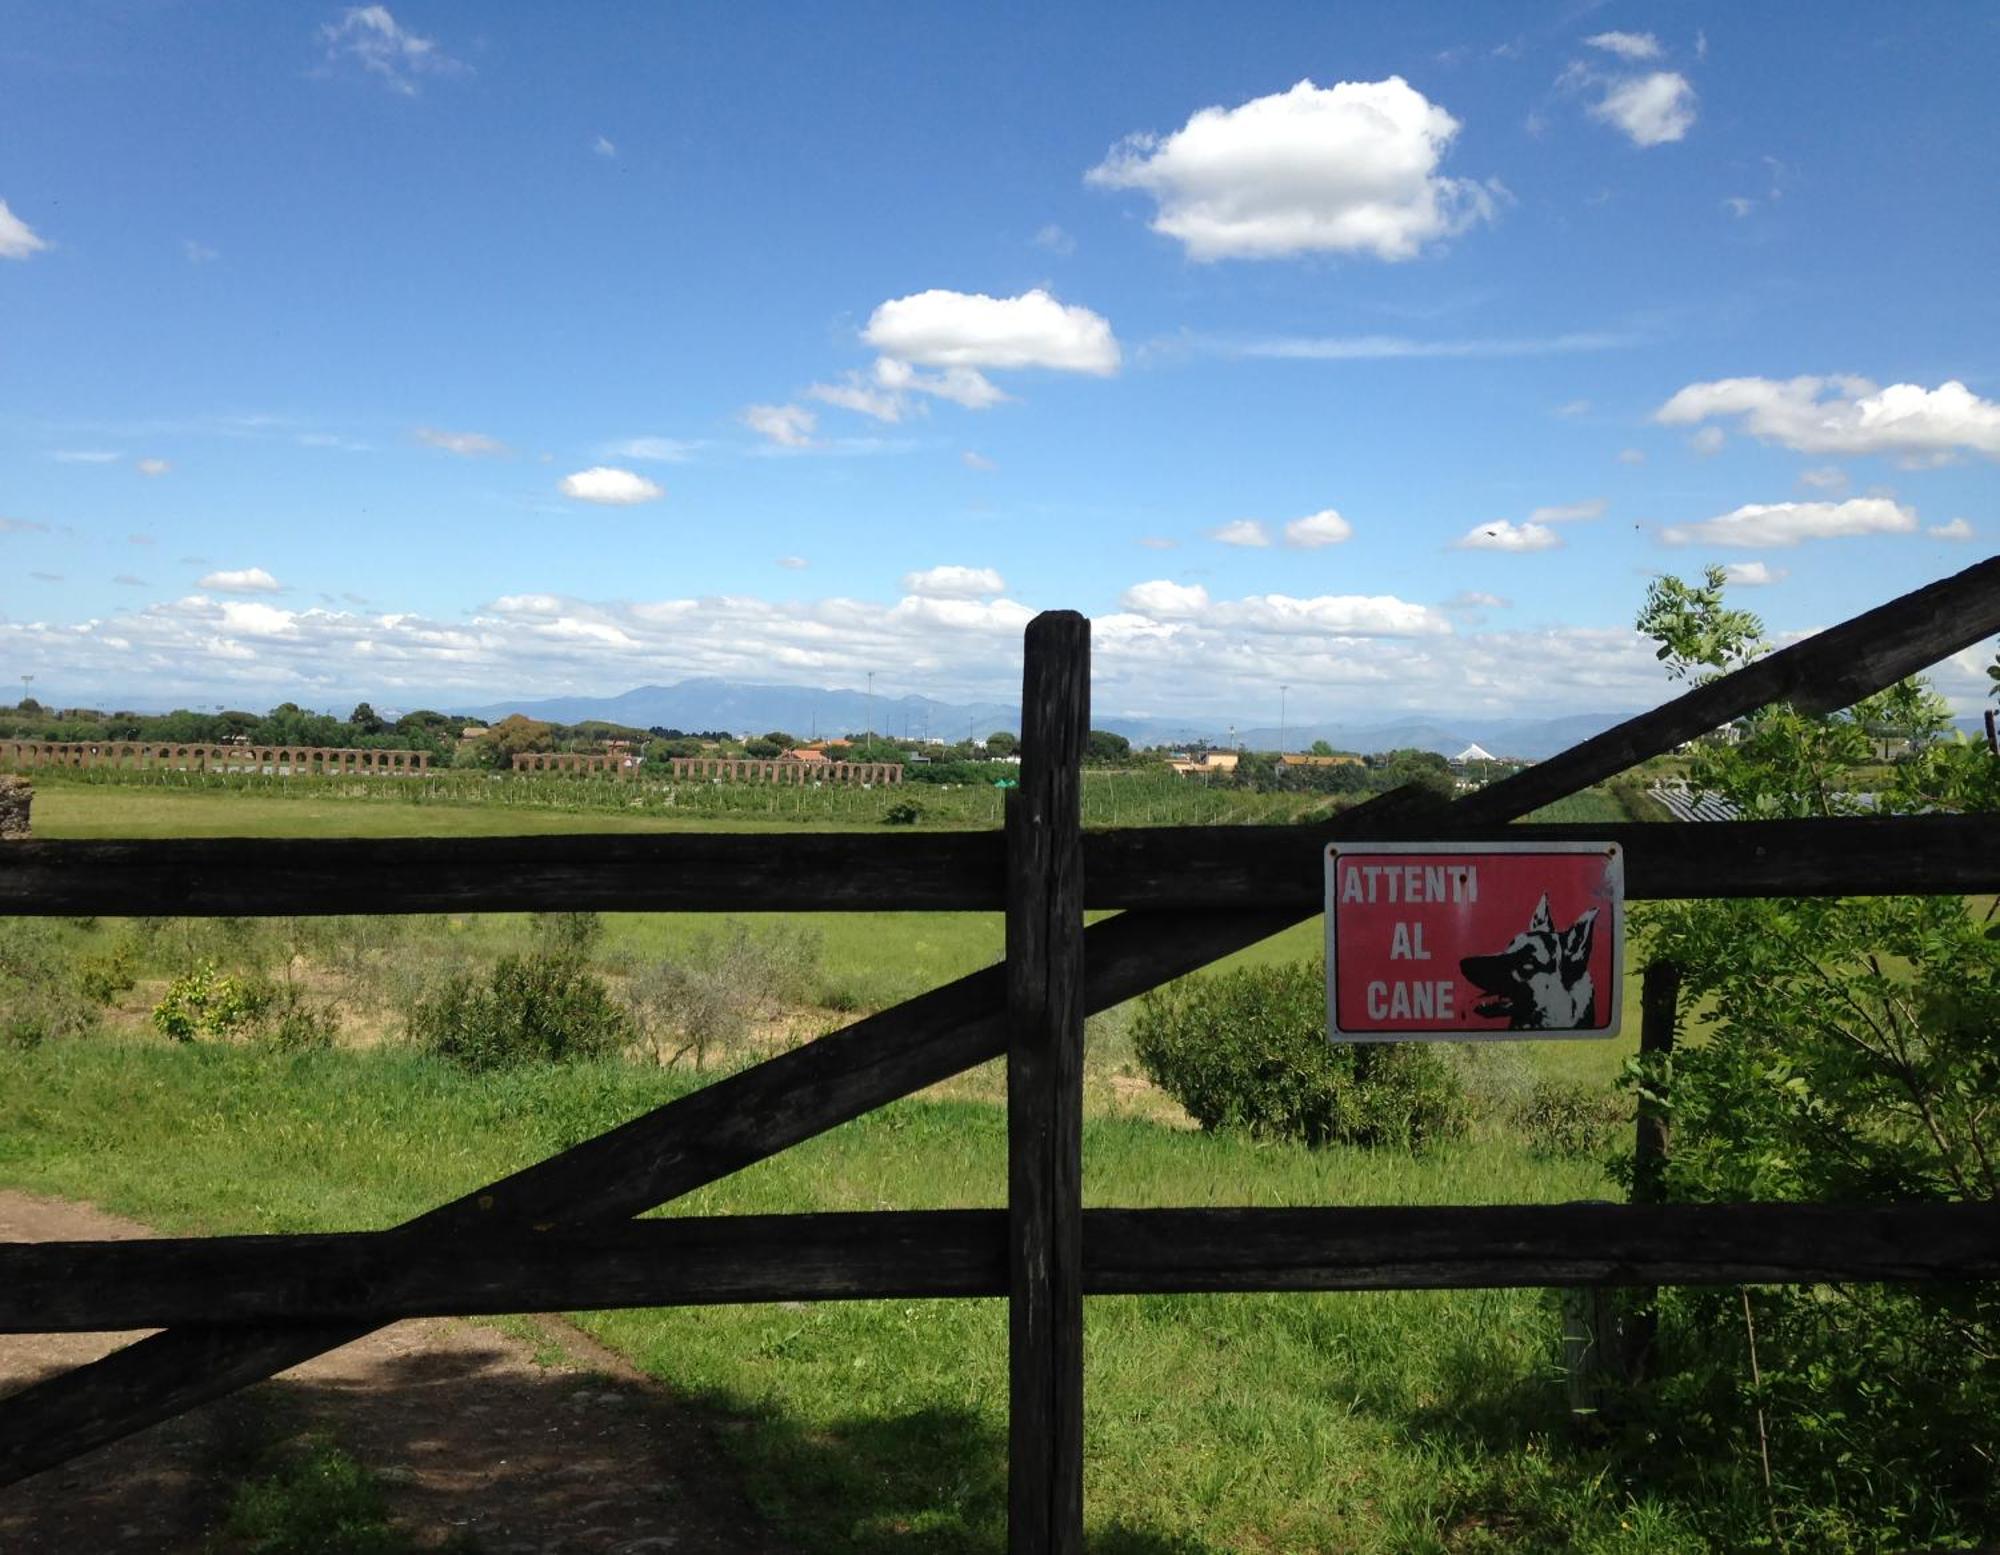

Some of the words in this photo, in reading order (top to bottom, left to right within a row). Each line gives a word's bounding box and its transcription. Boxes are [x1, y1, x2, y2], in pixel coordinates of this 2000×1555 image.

[1343, 866, 1478, 903] ATTENTI
[1390, 922, 1431, 960] AL
[1367, 981, 1455, 1020] CANE
